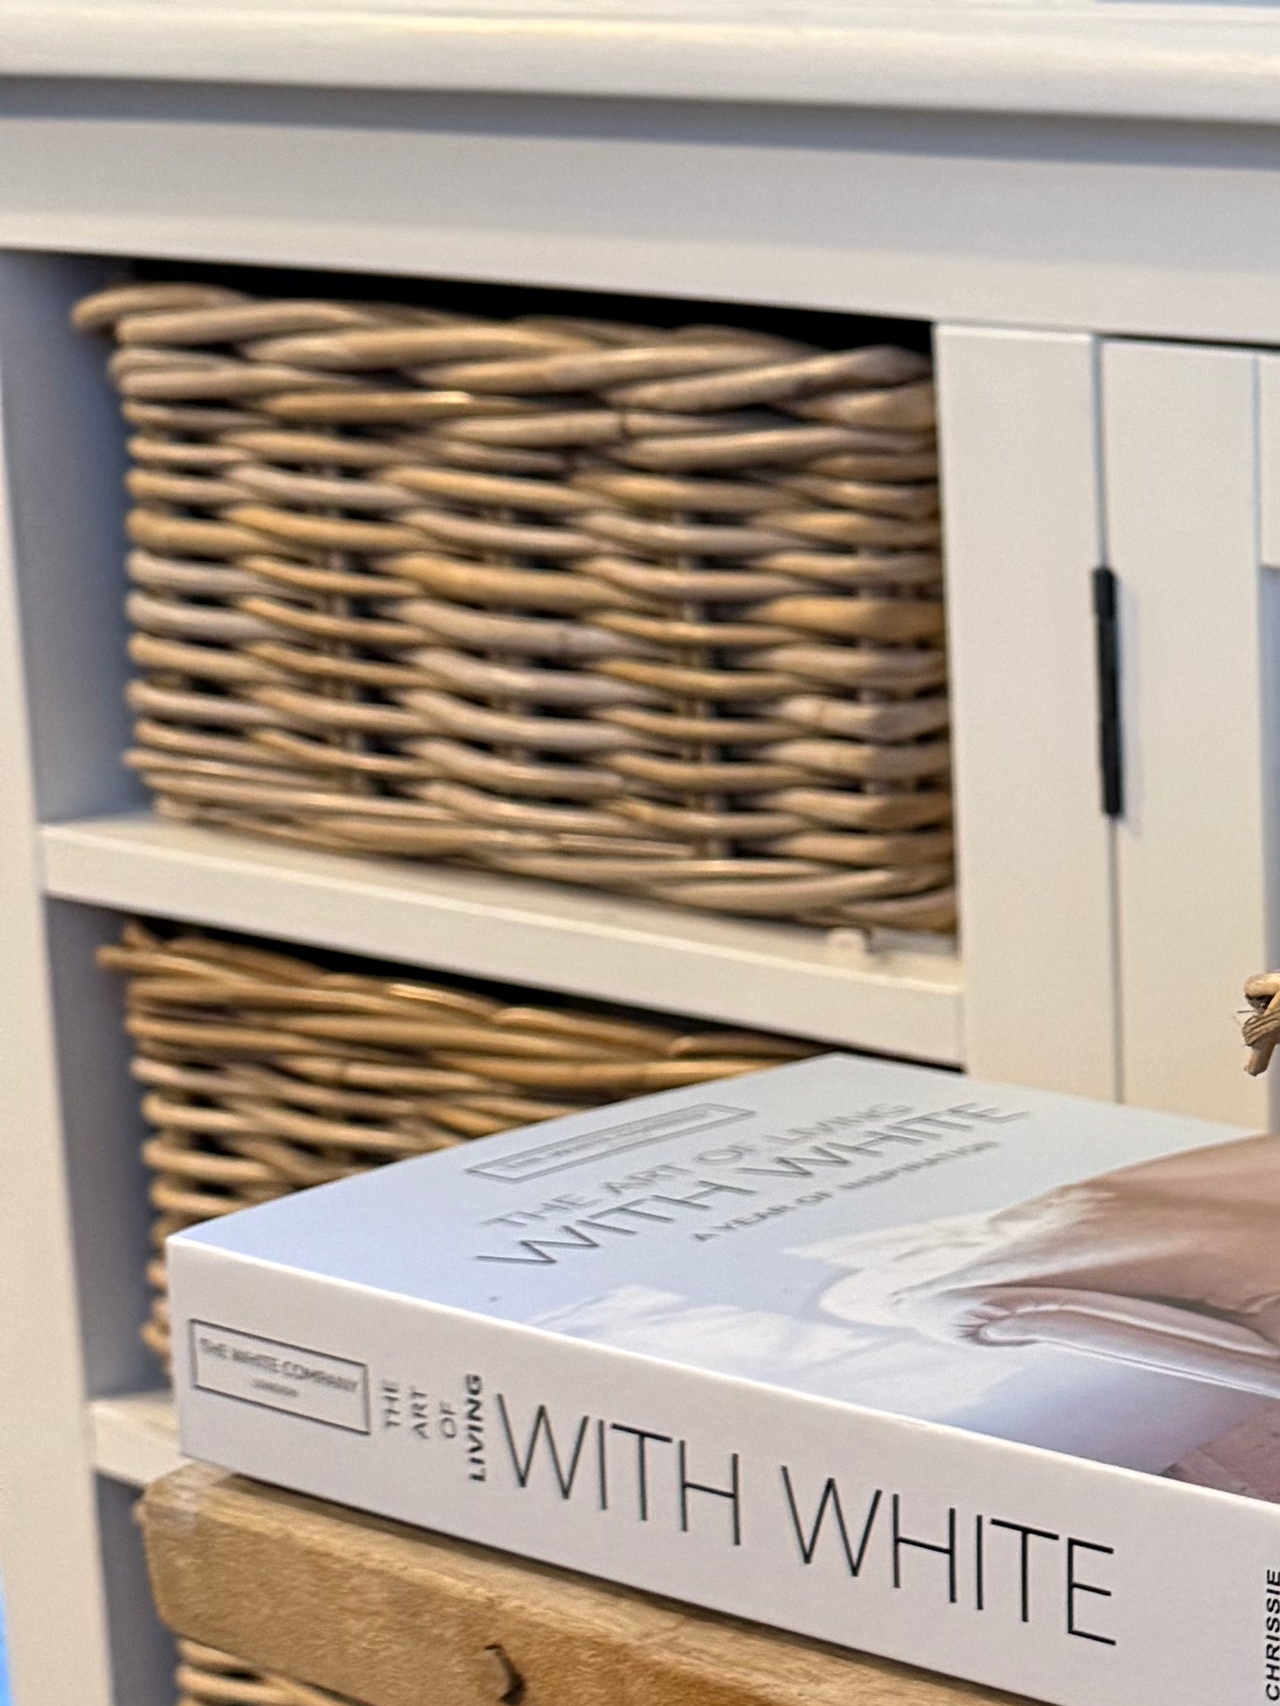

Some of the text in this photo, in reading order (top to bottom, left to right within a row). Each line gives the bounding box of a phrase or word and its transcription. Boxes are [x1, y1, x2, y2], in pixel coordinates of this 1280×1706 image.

[474, 1179, 757, 1265] WITH
[734, 1101, 1031, 1179] WHITE
[479, 1102, 914, 1229] THE ART OF LIVING
[381, 1378, 402, 1430] THE
[410, 1385, 430, 1440] ART
[439, 1399, 458, 1440] OF
[465, 1373, 486, 1483] LIVING
[497, 1392, 1117, 1647] WITH WHITE
